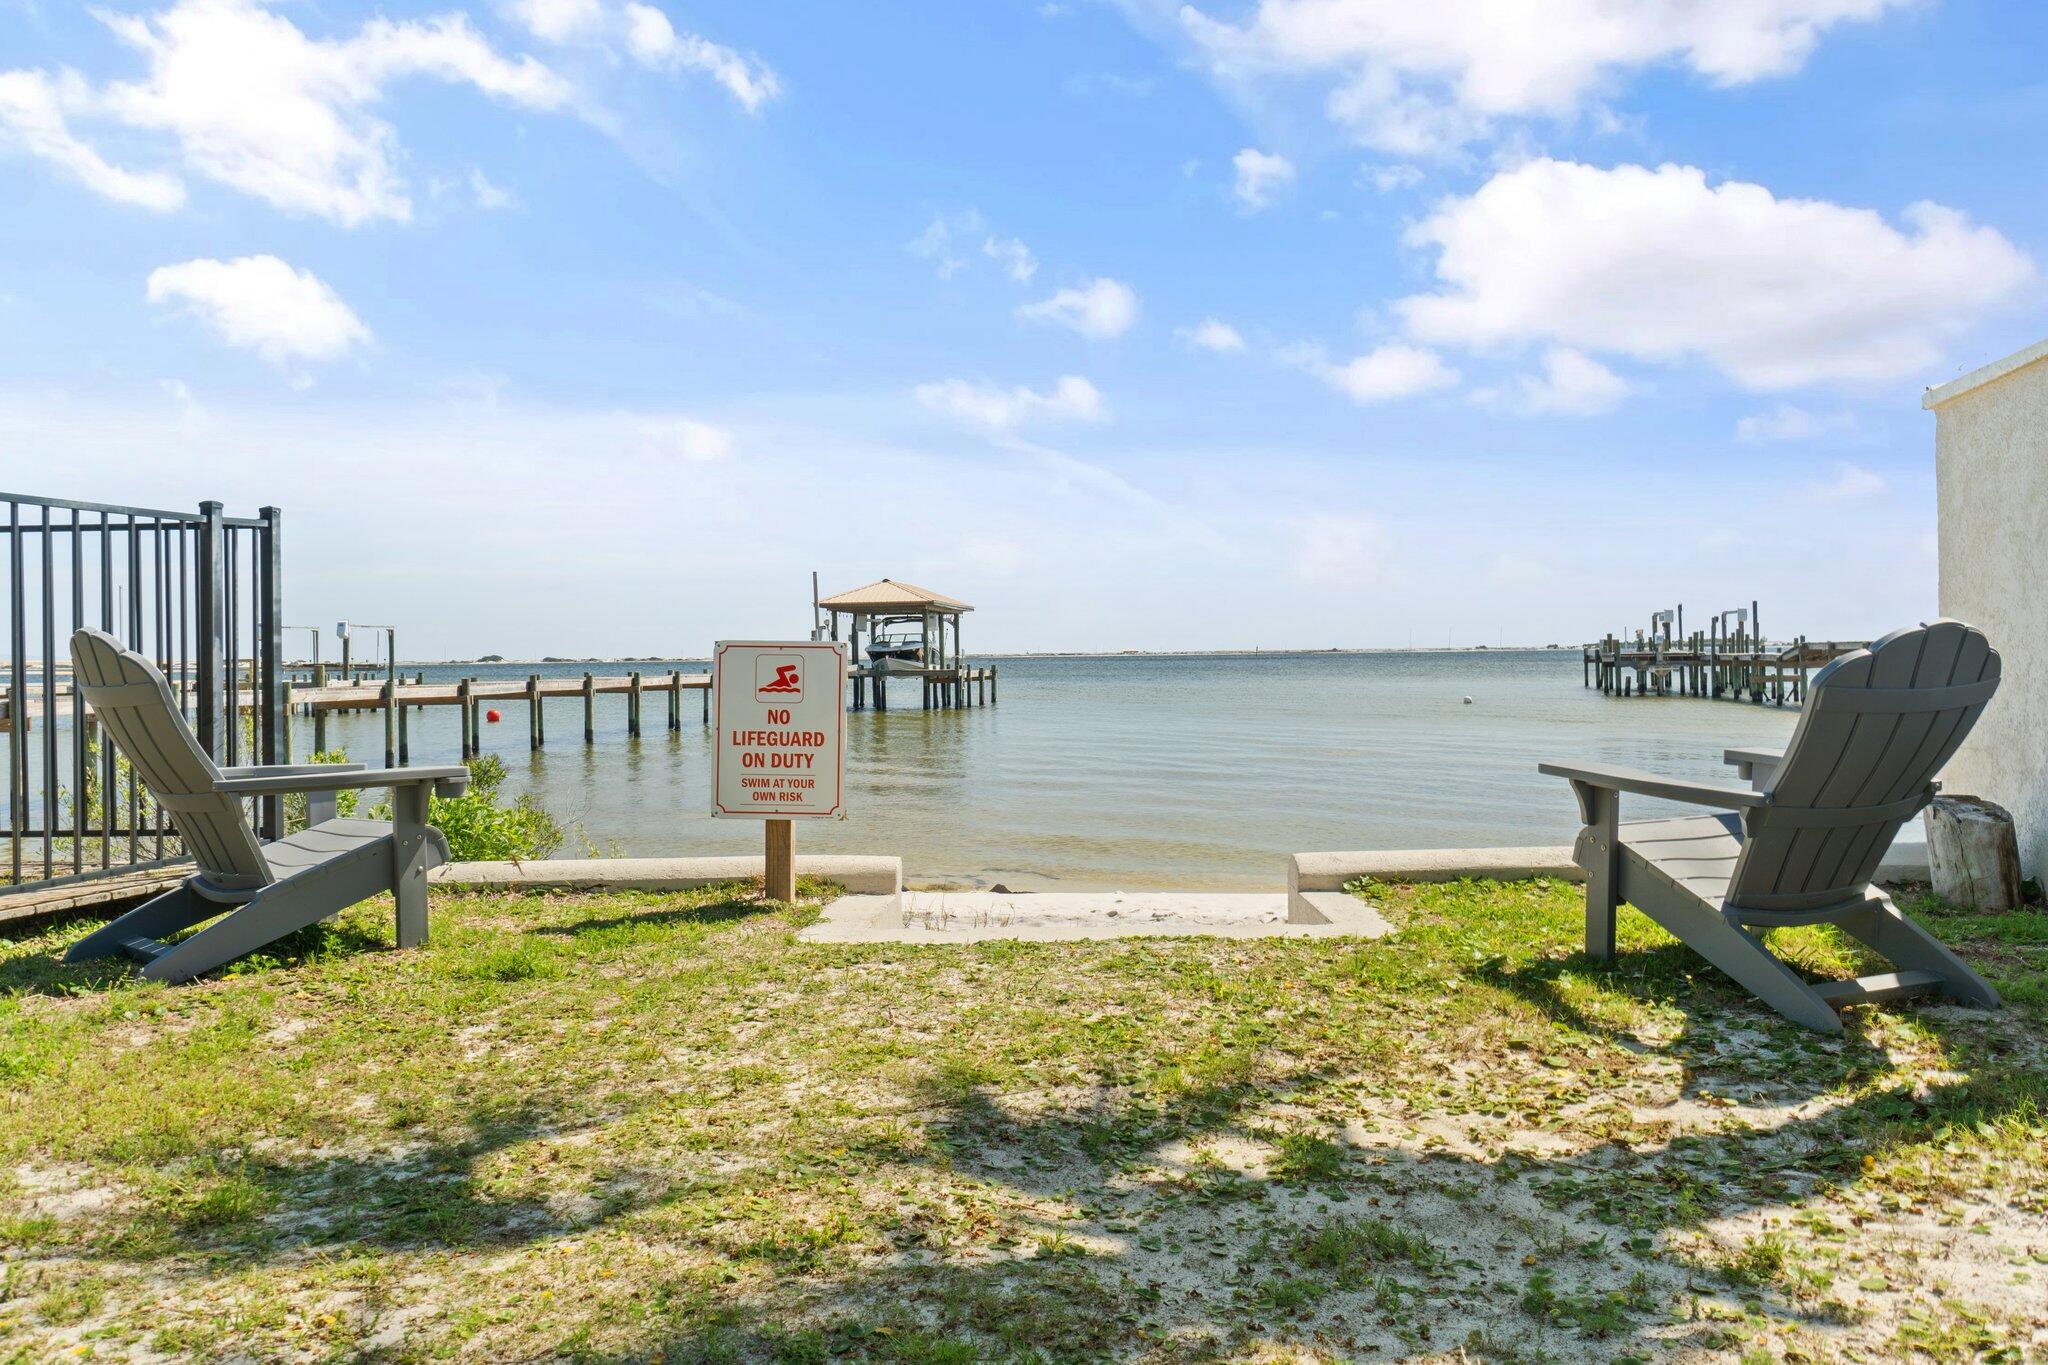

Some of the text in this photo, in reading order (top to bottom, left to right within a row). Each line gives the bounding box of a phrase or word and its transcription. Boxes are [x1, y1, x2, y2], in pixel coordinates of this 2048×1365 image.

[767, 709, 791, 725] NO
[732, 730, 825, 747] LIFEGUARD
[742, 752, 815, 769] ON DUTY
[741, 778, 815, 789] SWIM AT YOUR
[752, 791, 803, 802] OWN RISK
